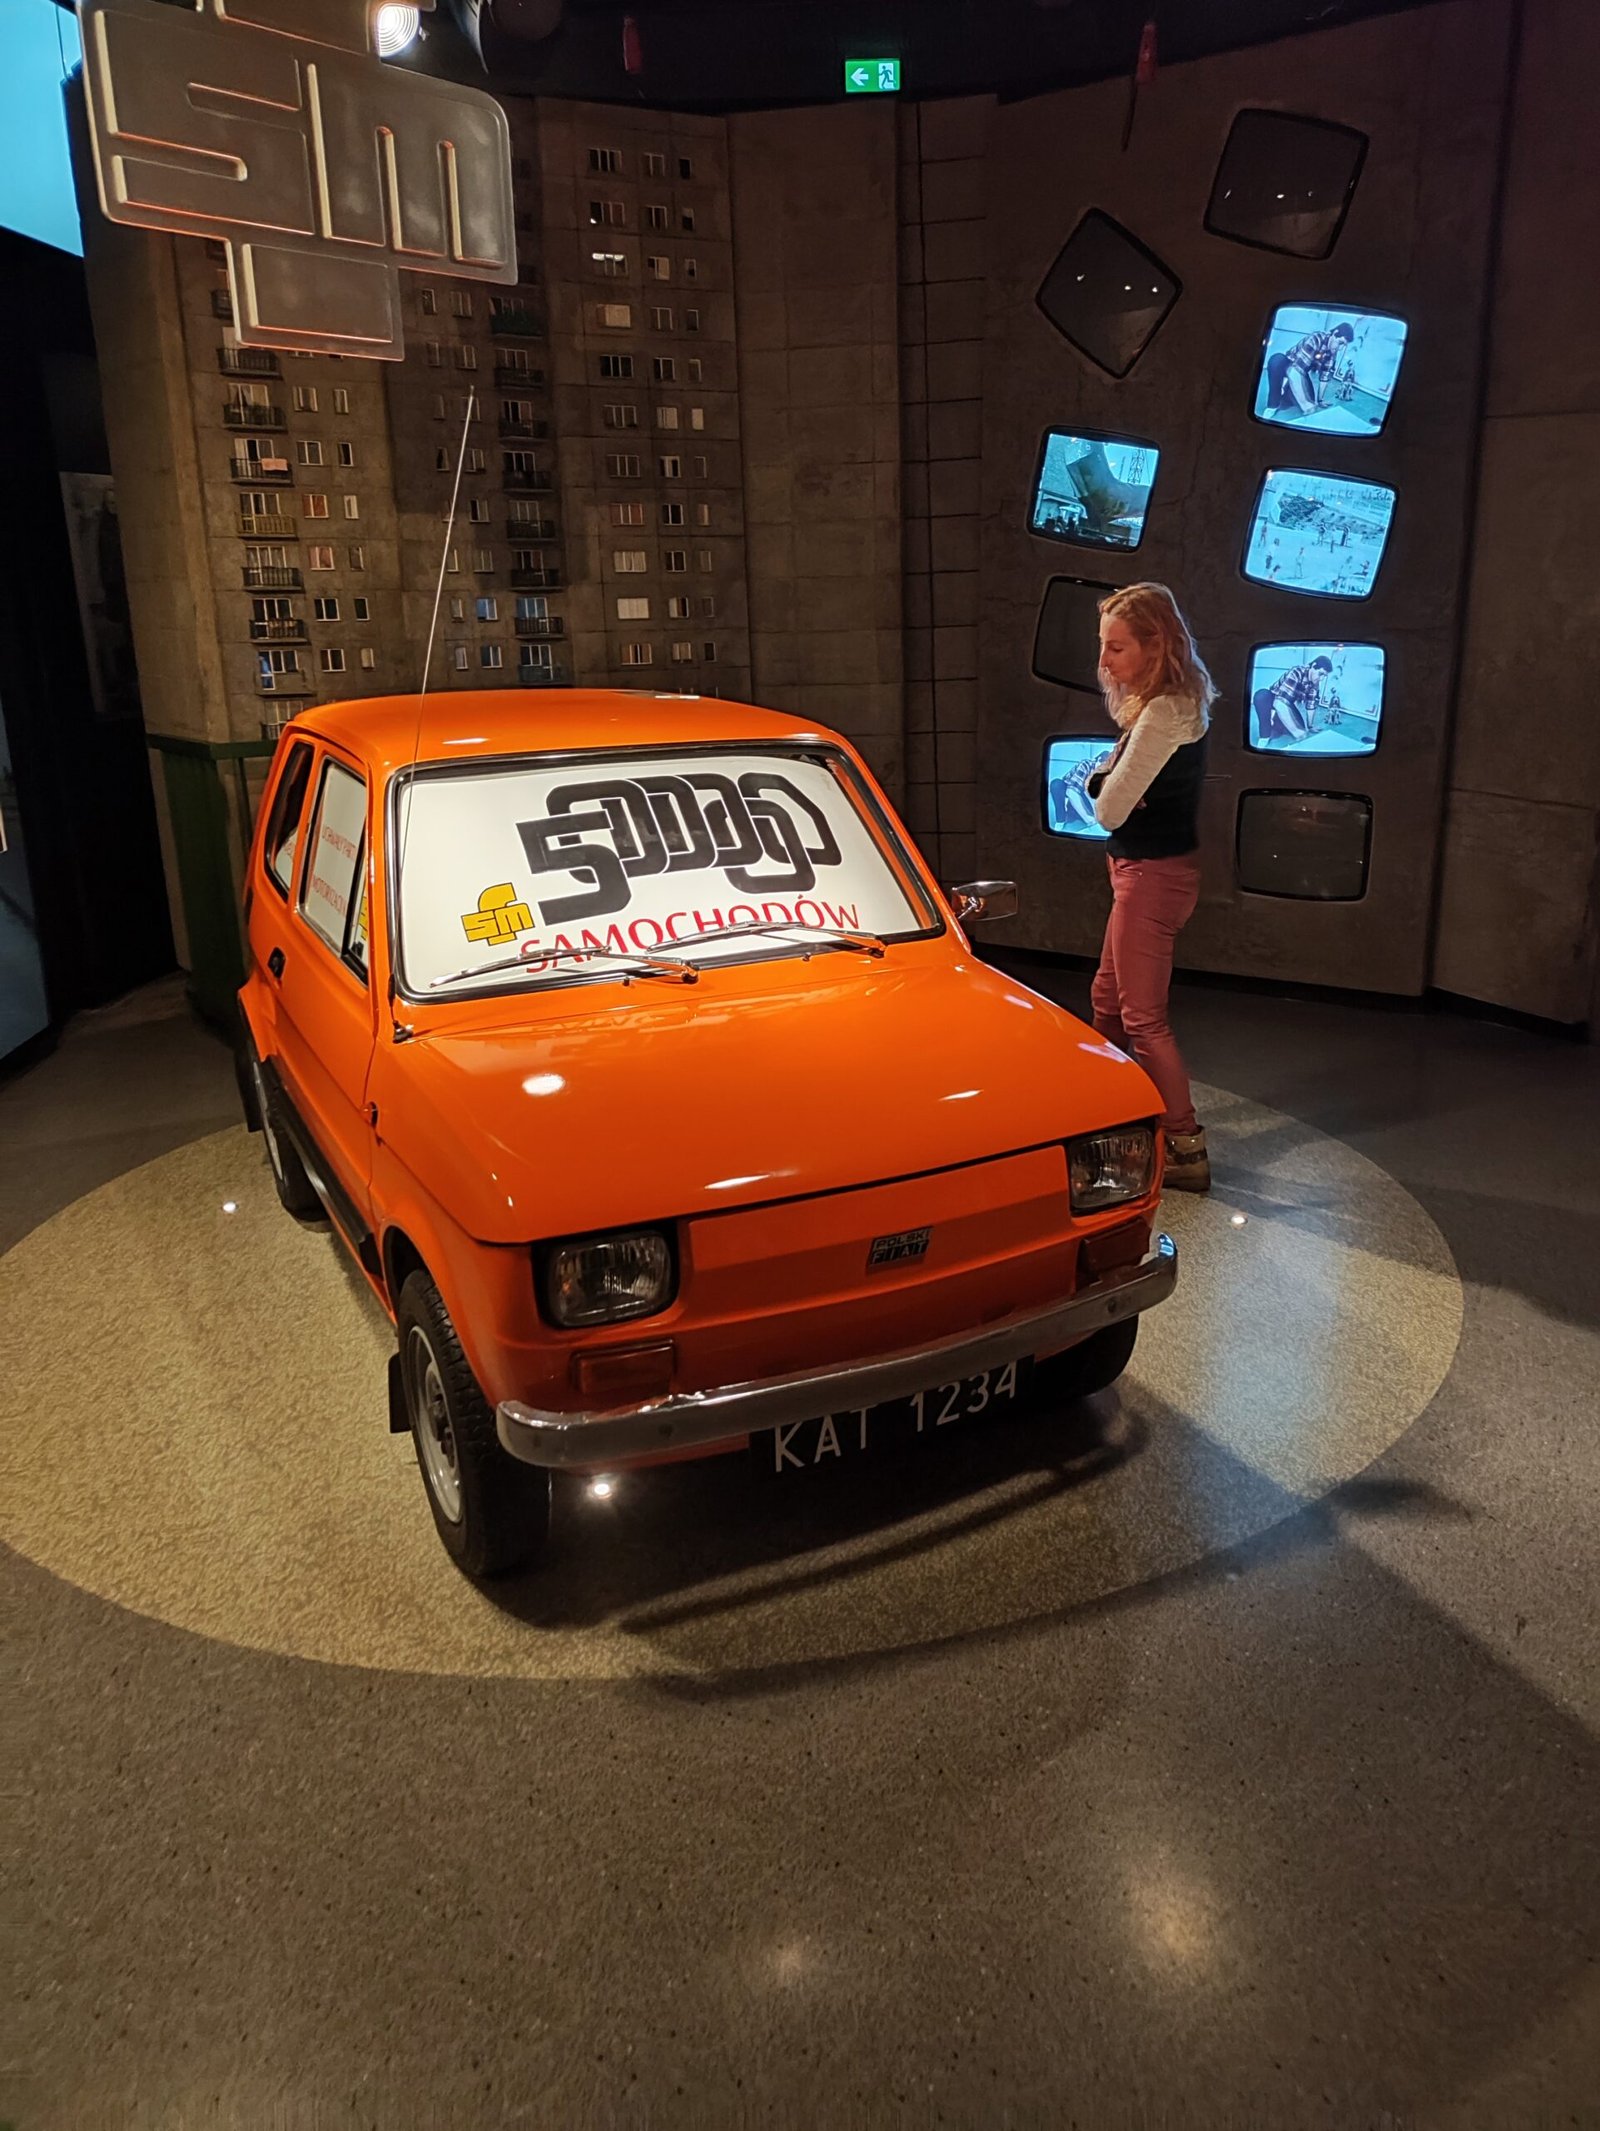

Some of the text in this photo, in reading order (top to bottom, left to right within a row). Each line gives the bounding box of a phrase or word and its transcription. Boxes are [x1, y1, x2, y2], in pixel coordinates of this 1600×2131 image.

[519, 893, 860, 974] SAMOCHODÓW
[871, 1241, 924, 1265] FIAT
[872, 1228, 930, 1251] POLSKI
[773, 1360, 1018, 1473] KAT 1234
